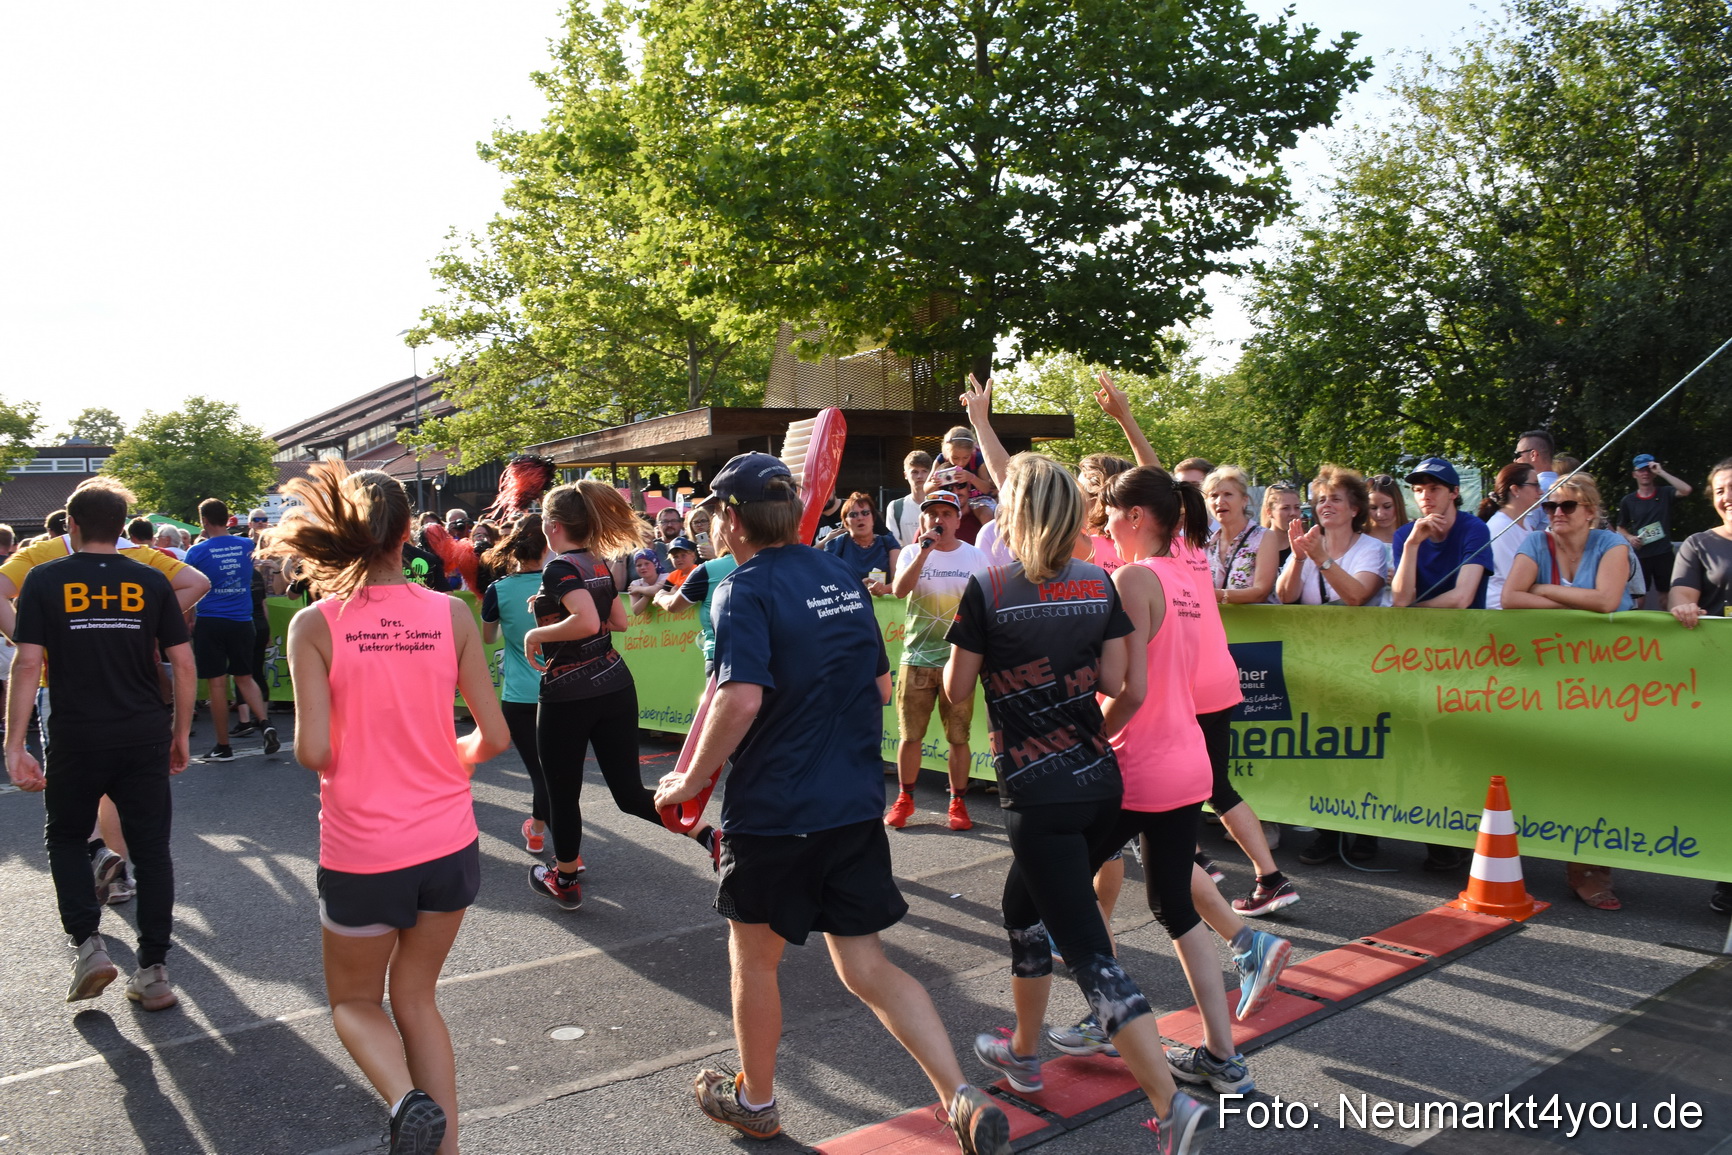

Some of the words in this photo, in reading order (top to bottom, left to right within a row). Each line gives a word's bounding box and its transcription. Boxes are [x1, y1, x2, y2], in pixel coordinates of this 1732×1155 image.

[219, 563, 241, 571] LAUFEN
[932, 568, 971, 579] firmenlauf
[820, 584, 839, 594] Dres.
[1038, 579, 1108, 601] HAARE
[63, 581, 145, 613] B+B
[806, 597, 834, 609] Hofmann
[840, 590, 861, 601] Schmidt
[817, 601, 864, 619] Kieferorthopäden
[69, 622, 141, 630] www.berschneider.com
[380, 618, 405, 628] Dres.
[345, 630, 390, 642] Hofmann
[405, 630, 442, 640] Schmidt
[624, 629, 658, 650] laufen
[358, 641, 435, 654] Kieferorthopäden
[1531, 633, 1664, 666] Firmen
[1436, 676, 1543, 713] laufen
[1557, 668, 1702, 722] länger!
